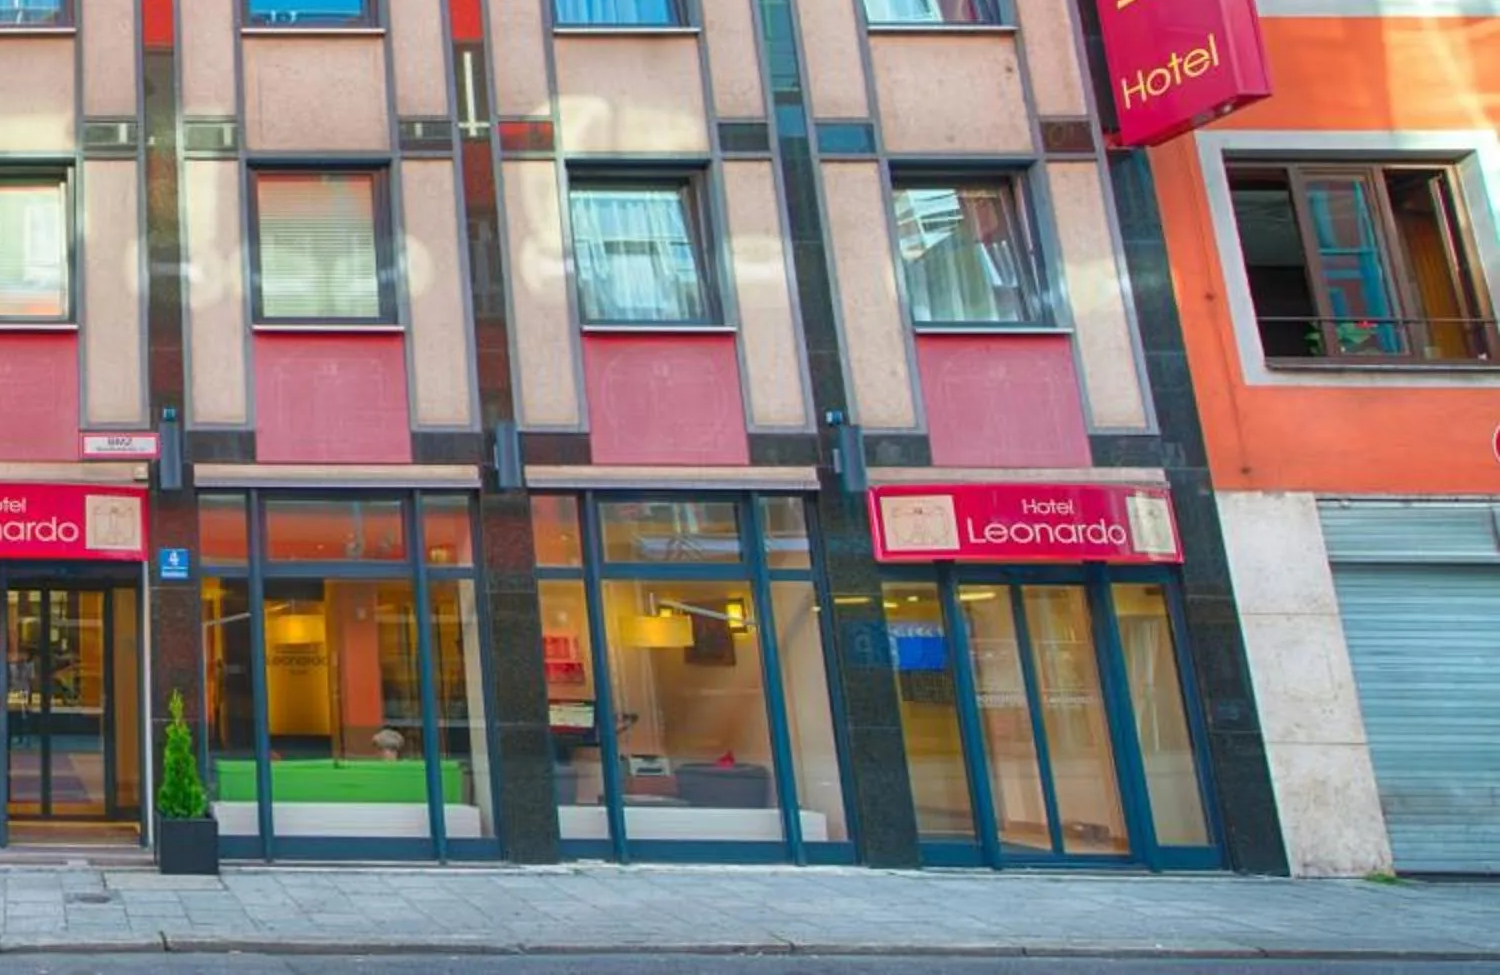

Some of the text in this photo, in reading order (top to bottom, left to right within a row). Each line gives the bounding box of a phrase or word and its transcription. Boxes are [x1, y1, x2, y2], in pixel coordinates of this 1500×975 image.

[1121, 34, 1221, 110] Hotel
[1021, 498, 1076, 516] Hotel
[966, 518, 1128, 546] Leonardo
[168, 548, 180, 566] 4
